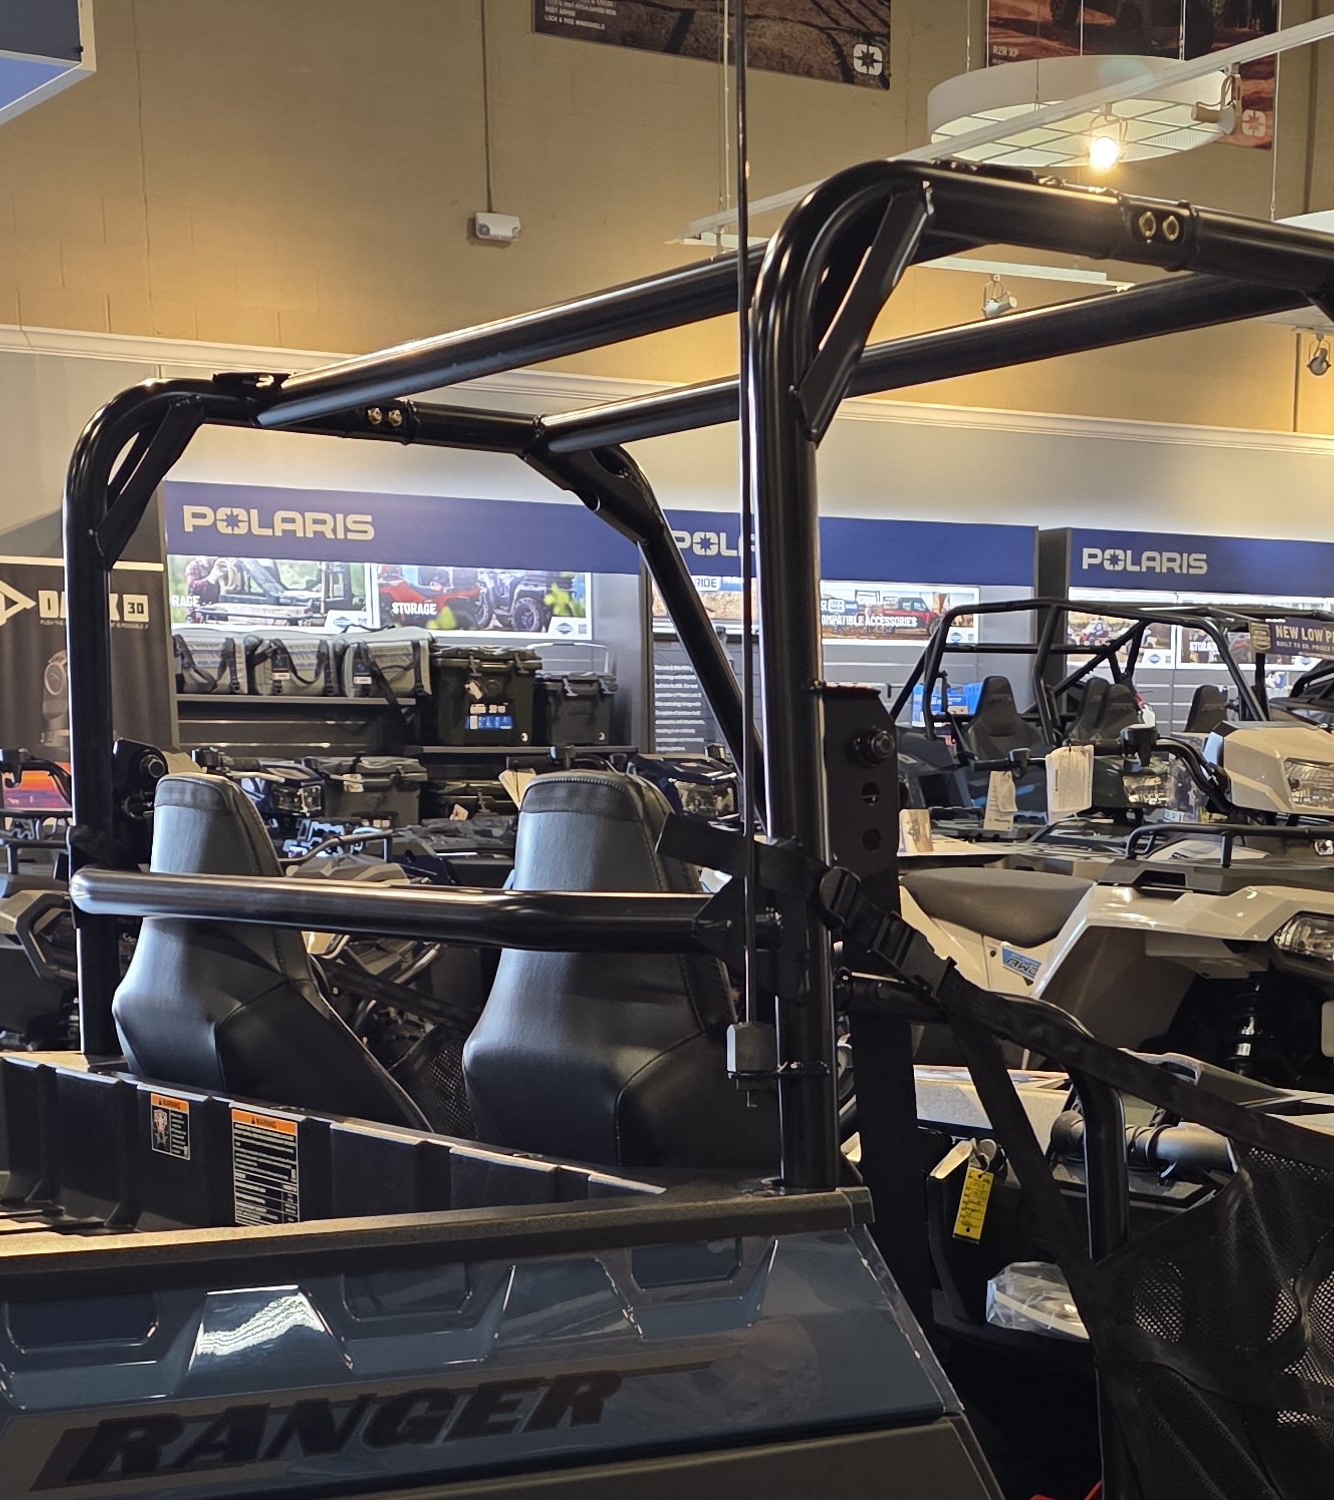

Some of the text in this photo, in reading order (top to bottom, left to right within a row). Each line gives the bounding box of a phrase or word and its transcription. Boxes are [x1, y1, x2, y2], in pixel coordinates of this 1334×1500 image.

[992, 45, 1019, 58] RZR XP
[183, 505, 375, 541] POLARIS
[1082, 547, 1208, 575] POLARIS
[392, 602, 437, 615] STORAGE
[865, 616, 917, 628] ACCESSORIES
[1275, 625, 1299, 640] NEW
[1301, 627, 1324, 643] LOW
[47, 1369, 623, 1487] RANGER
